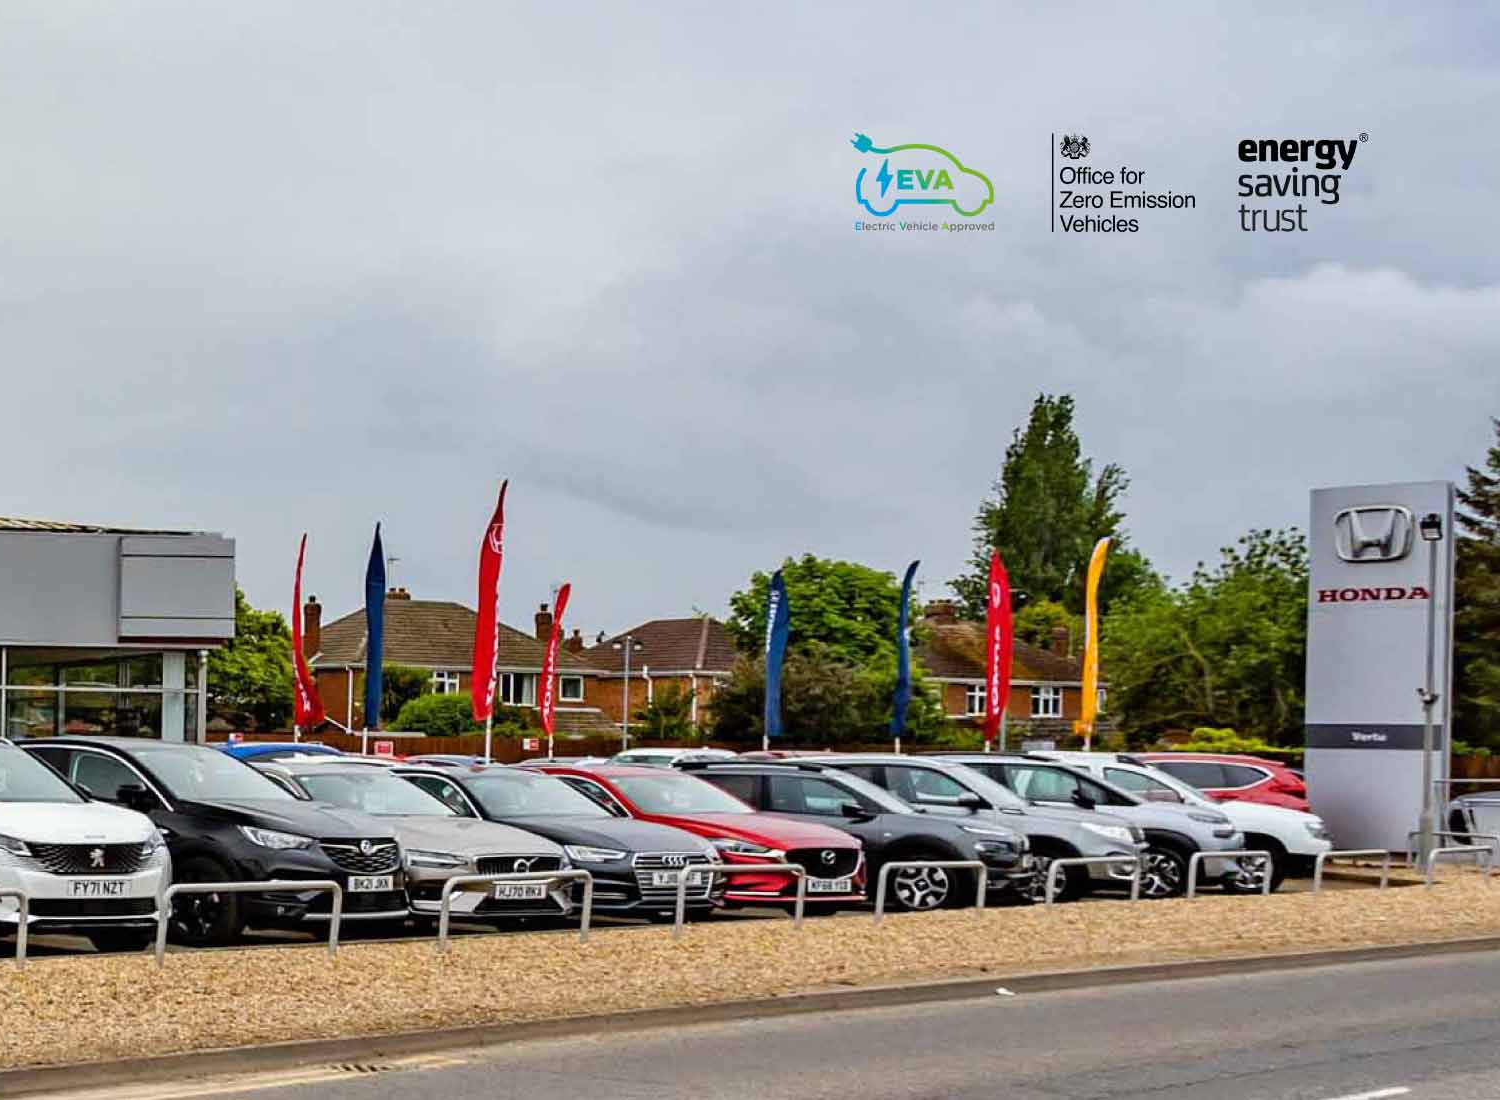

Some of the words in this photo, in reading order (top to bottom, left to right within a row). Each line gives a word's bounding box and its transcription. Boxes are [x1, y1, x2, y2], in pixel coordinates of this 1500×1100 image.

[1317, 586, 1430, 603] HONDA
[73, 881, 101, 895] FY71
[103, 881, 125, 895] NZT
